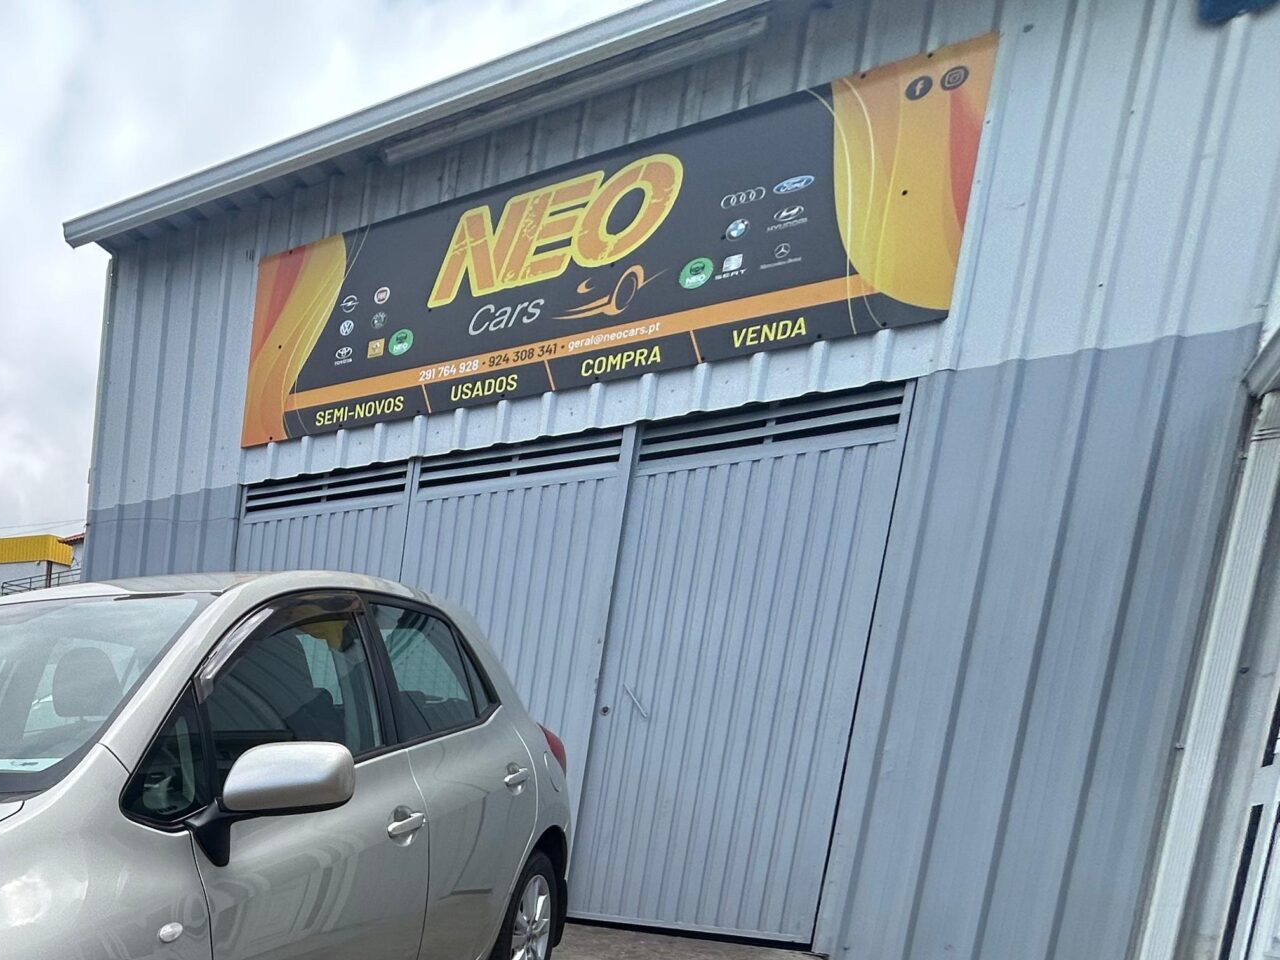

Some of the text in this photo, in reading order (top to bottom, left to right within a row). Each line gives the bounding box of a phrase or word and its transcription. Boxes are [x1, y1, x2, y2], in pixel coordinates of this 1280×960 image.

[428, 152, 684, 309] NEO
[714, 268, 747, 280] SEAT
[468, 298, 545, 336] Cars
[732, 317, 807, 348] VENDA
[418, 321, 661, 382] 291 764 928 924 308 341 geral@neocars.pt
[580, 345, 662, 377] COMPRA
[450, 374, 518, 402] USADOS
[315, 396, 404, 426] SEMI-NOVOS
